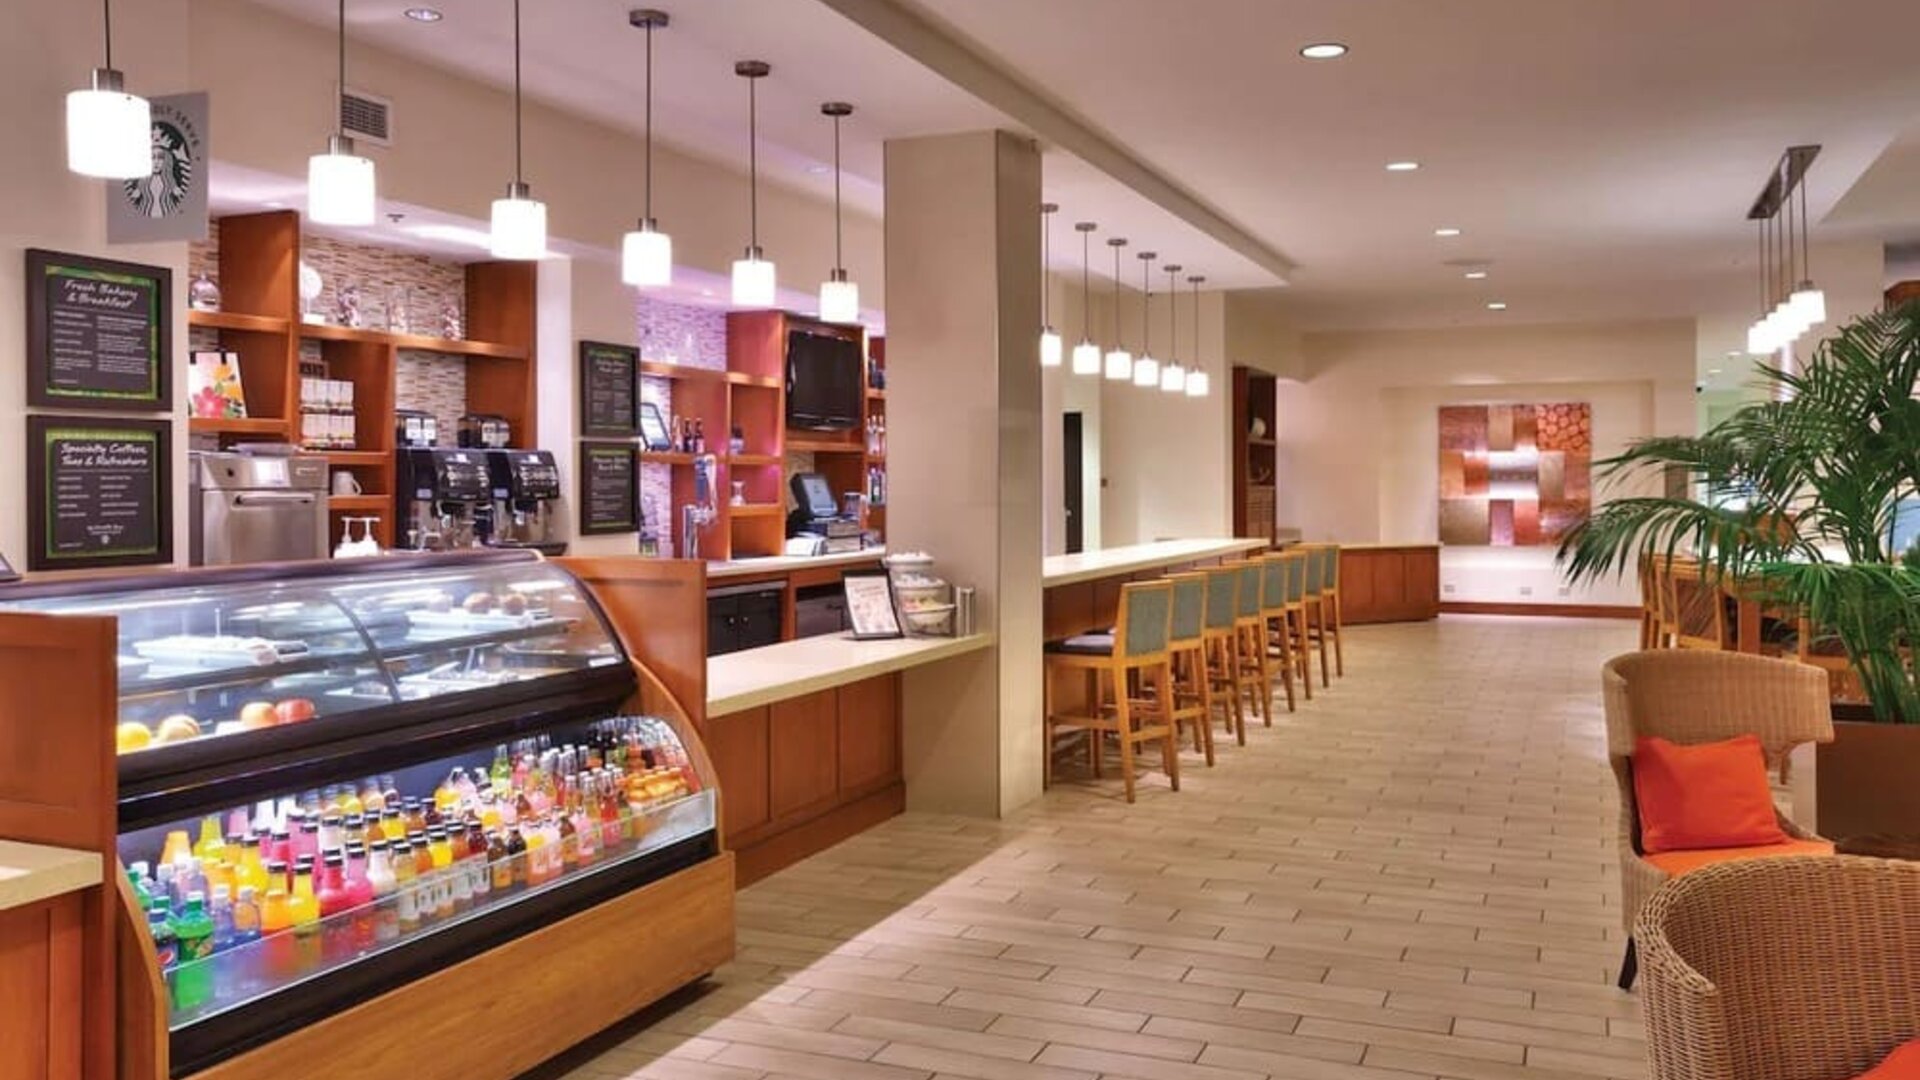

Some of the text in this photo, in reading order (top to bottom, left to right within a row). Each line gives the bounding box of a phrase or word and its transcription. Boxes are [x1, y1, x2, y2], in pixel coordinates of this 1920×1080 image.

[64, 279, 138, 301] Fresh Bakery
[66, 292, 133, 309] & Breakfast
[84, 455, 94, 467] &
